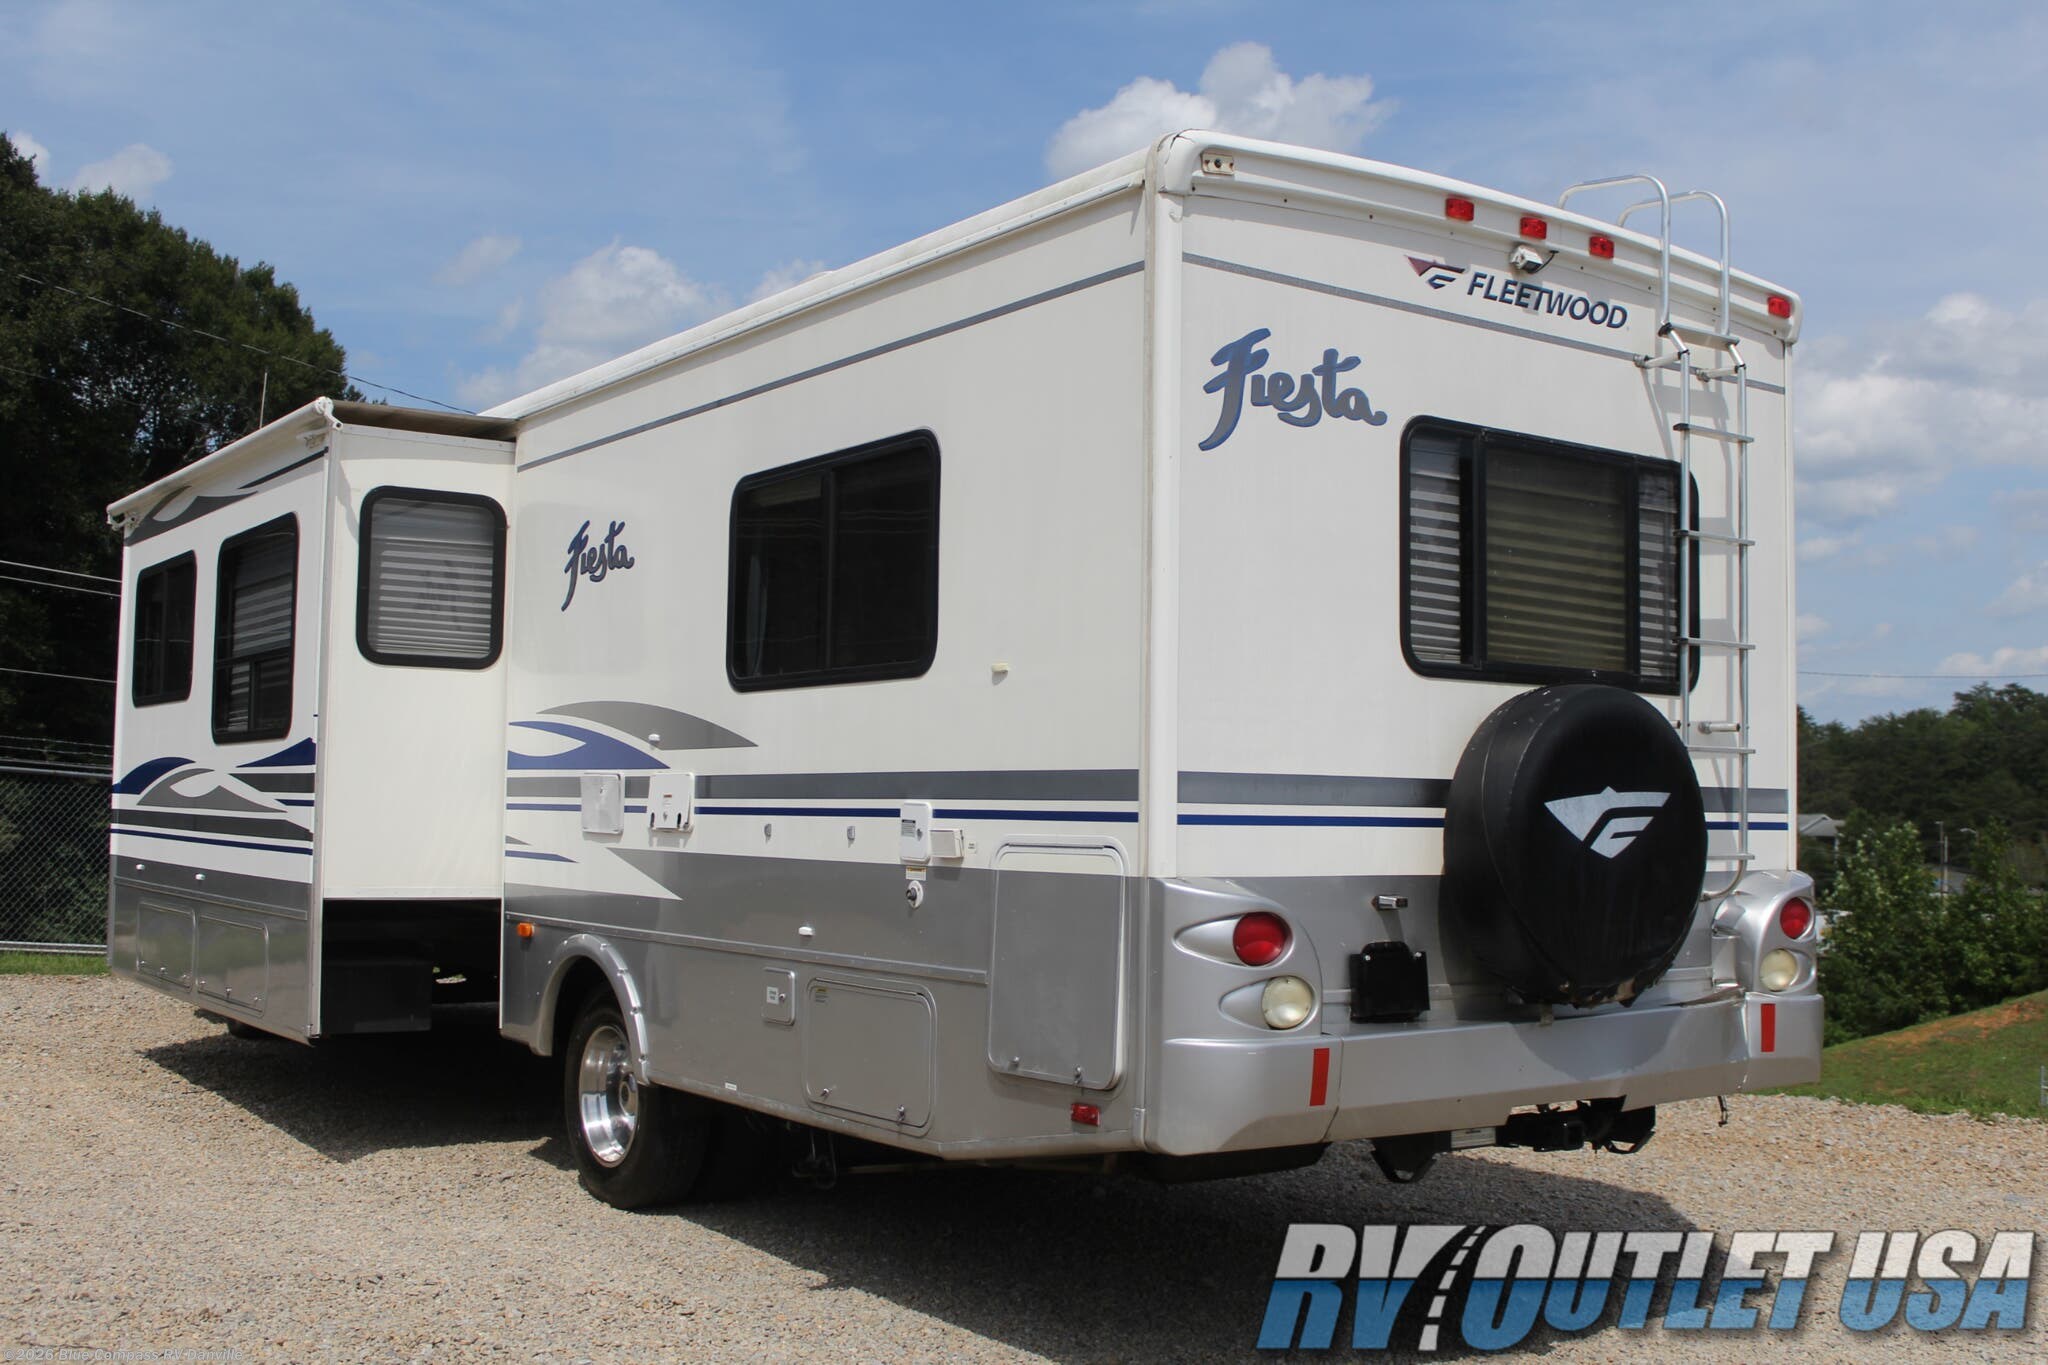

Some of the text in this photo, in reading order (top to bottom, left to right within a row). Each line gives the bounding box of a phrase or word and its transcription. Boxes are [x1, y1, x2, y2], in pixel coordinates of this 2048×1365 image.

[1467, 271, 1628, 328] FLEETWOOD
[1198, 328, 1388, 451] Fiesta
[561, 520, 635, 612] Fiesta
